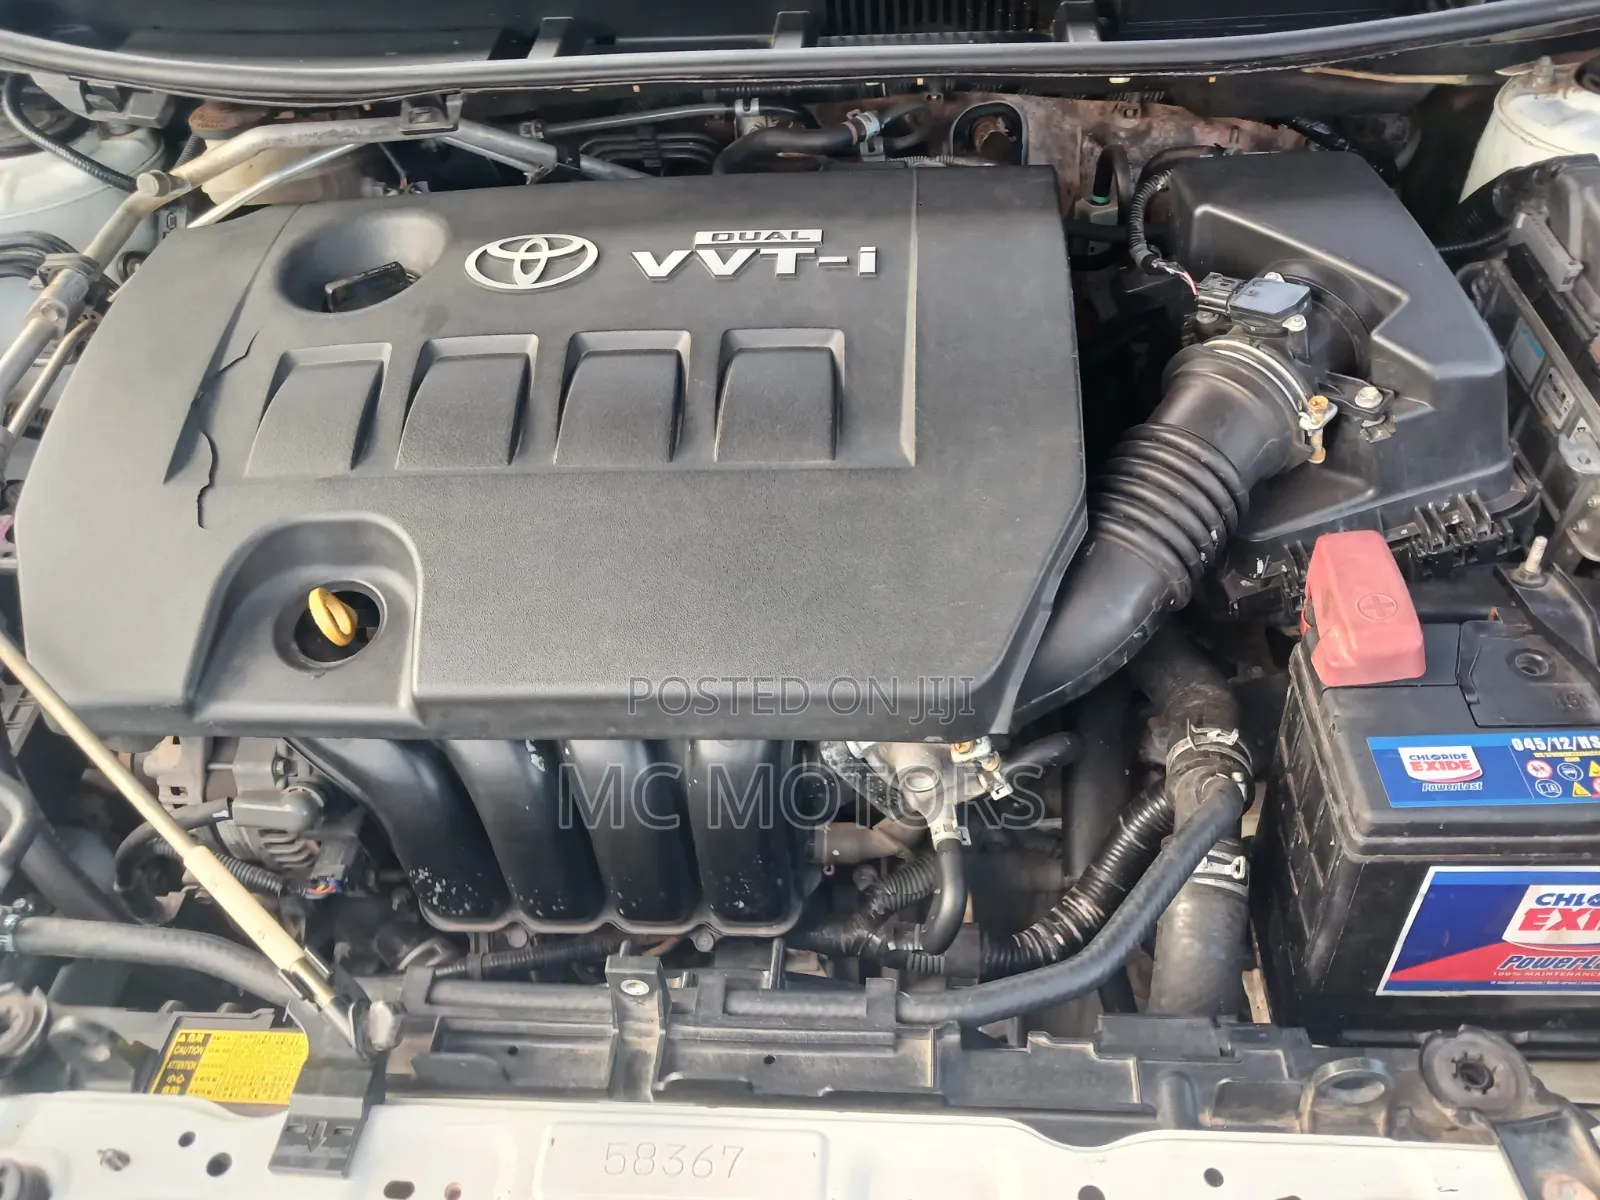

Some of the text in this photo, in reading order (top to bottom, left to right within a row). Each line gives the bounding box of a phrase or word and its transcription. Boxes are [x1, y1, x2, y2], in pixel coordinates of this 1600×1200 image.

[710, 231, 811, 243] DUAL
[630, 246, 878, 280] VVT-i
[1408, 753, 1469, 761] CHLORIDE
[1409, 760, 1473, 772] EXIDE
[173, 1045, 205, 1056] CAUTION
[604, 1142, 744, 1179] 58367
